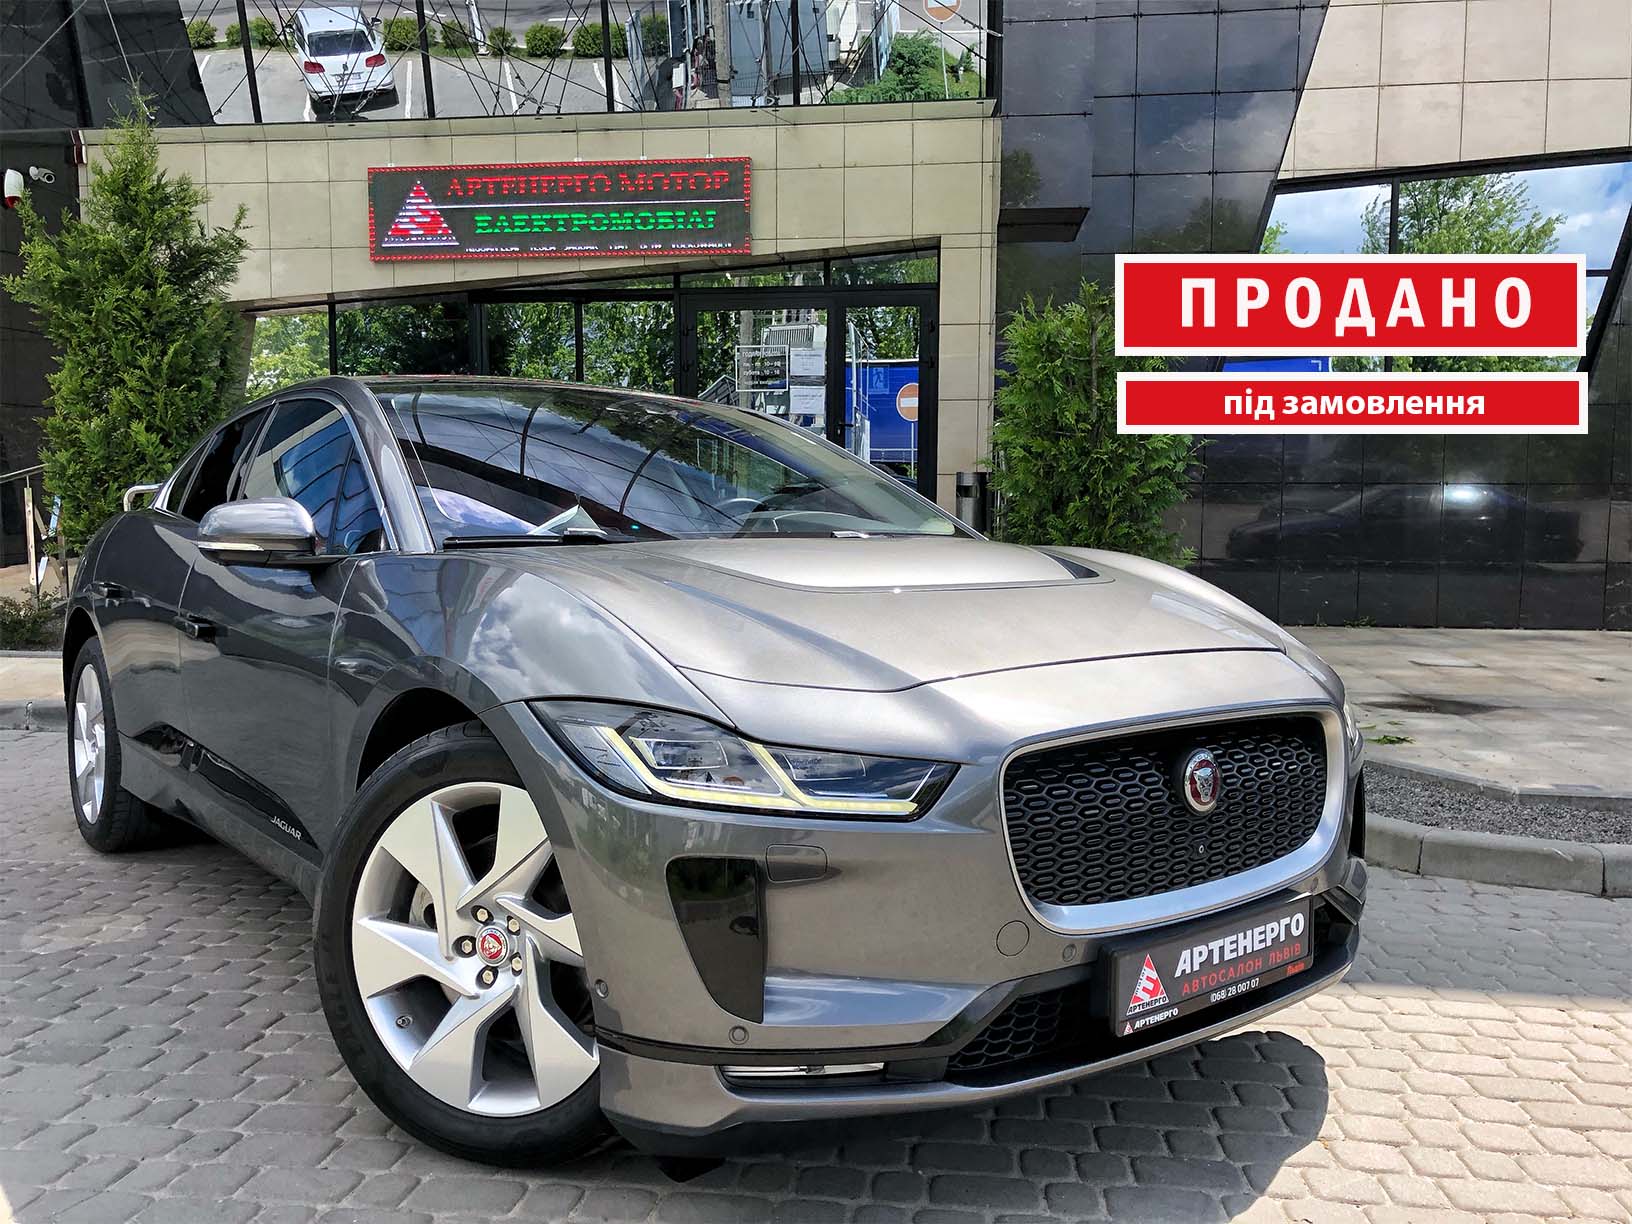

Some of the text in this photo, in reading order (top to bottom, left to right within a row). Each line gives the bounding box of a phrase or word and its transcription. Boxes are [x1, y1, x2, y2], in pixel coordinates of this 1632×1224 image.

[447, 170, 729, 196] АРТЕНЕРГО МОТОР
[270, 815, 302, 840] JAGUAR
[1174, 912, 1305, 978] АРТЕНЕРГО
[1181, 957, 1263, 996] АВТОСАЛОН
[1267, 942, 1301, 967] ЛЬВІВ
[1227, 985, 1237, 997] 28
[1237, 980, 1251, 993] 007
[1250, 977, 1260, 989] 07
[1127, 995, 1167, 1014] АРТЕНЕРГО
[1134, 1007, 1179, 1030] АРТЕНЕРГО
